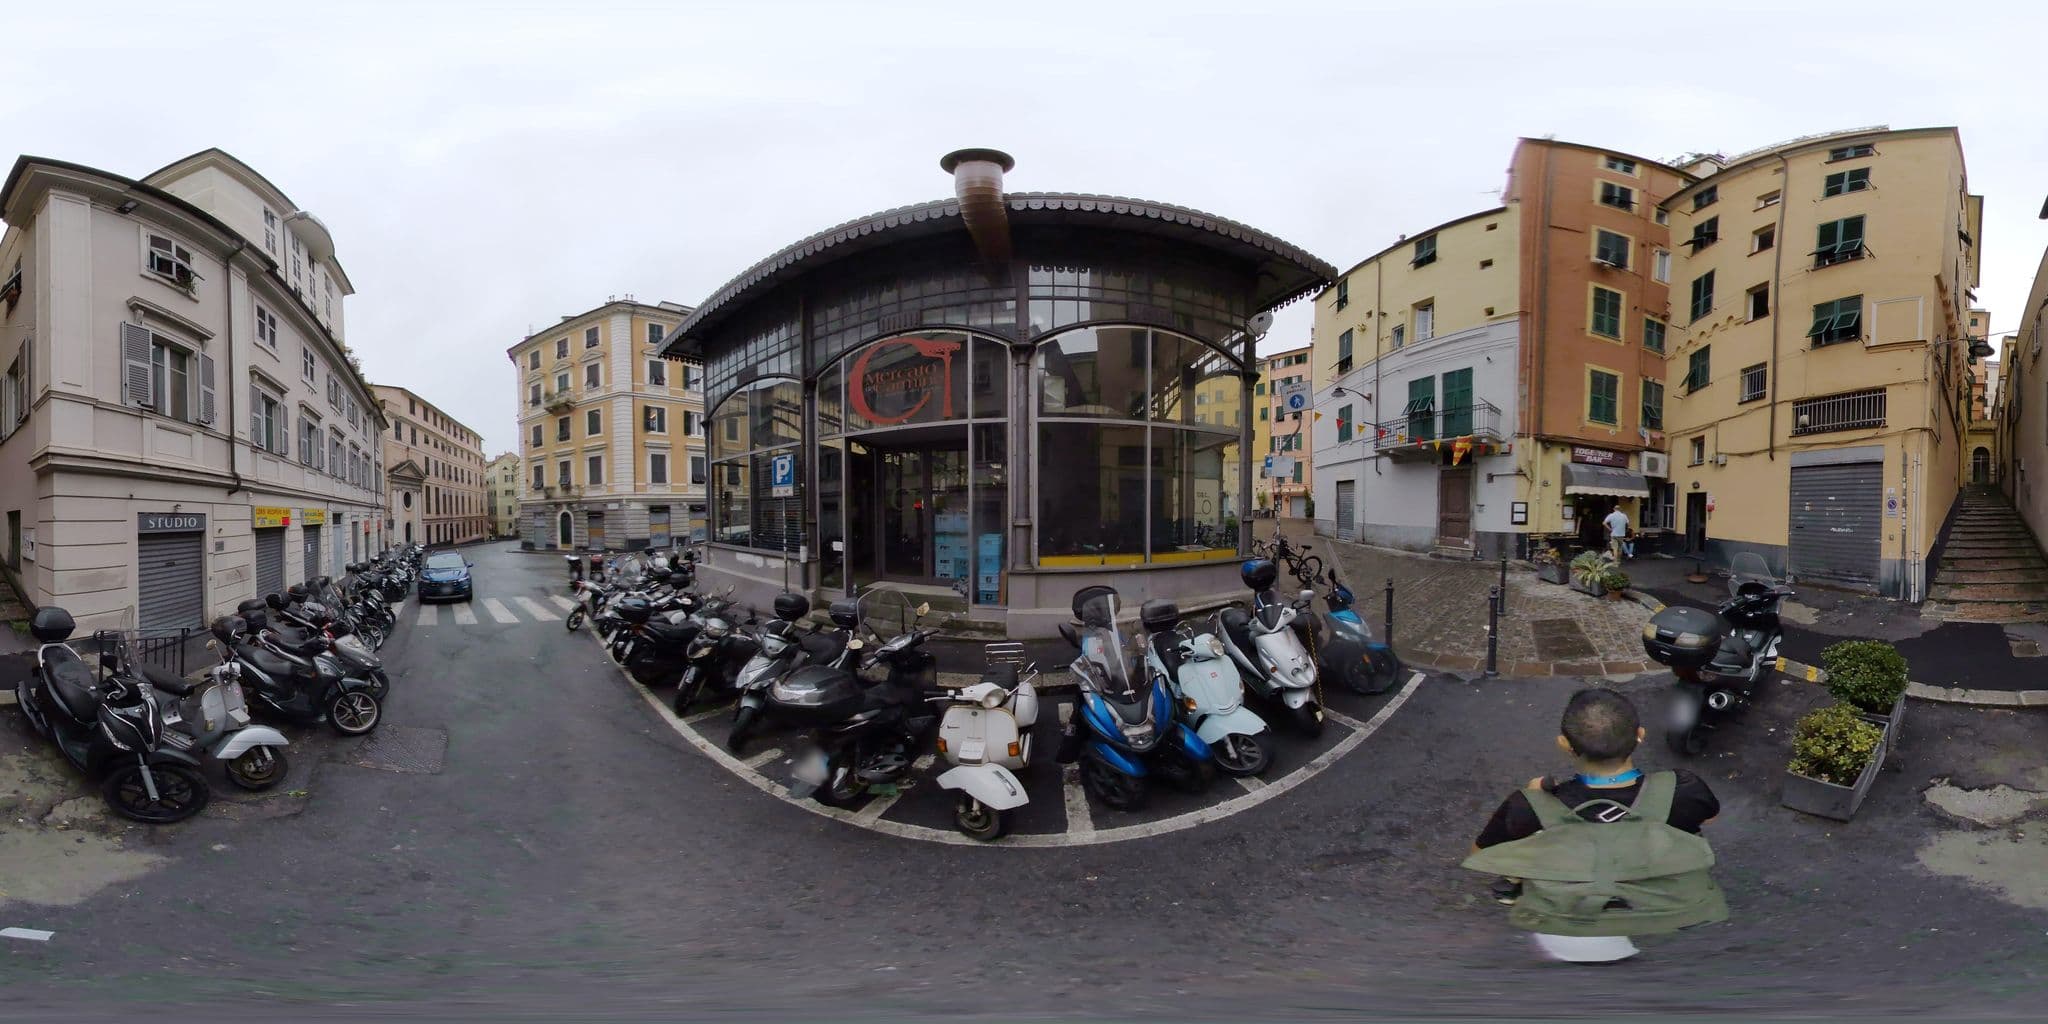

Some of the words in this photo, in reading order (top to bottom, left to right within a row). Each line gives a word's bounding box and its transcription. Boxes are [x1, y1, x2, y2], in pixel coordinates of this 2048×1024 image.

[864, 363, 937, 384] Mercato
[1575, 447, 1614, 459] TOGETHER
[776, 459, 790, 484] P
[148, 517, 197, 529] STUDIO
